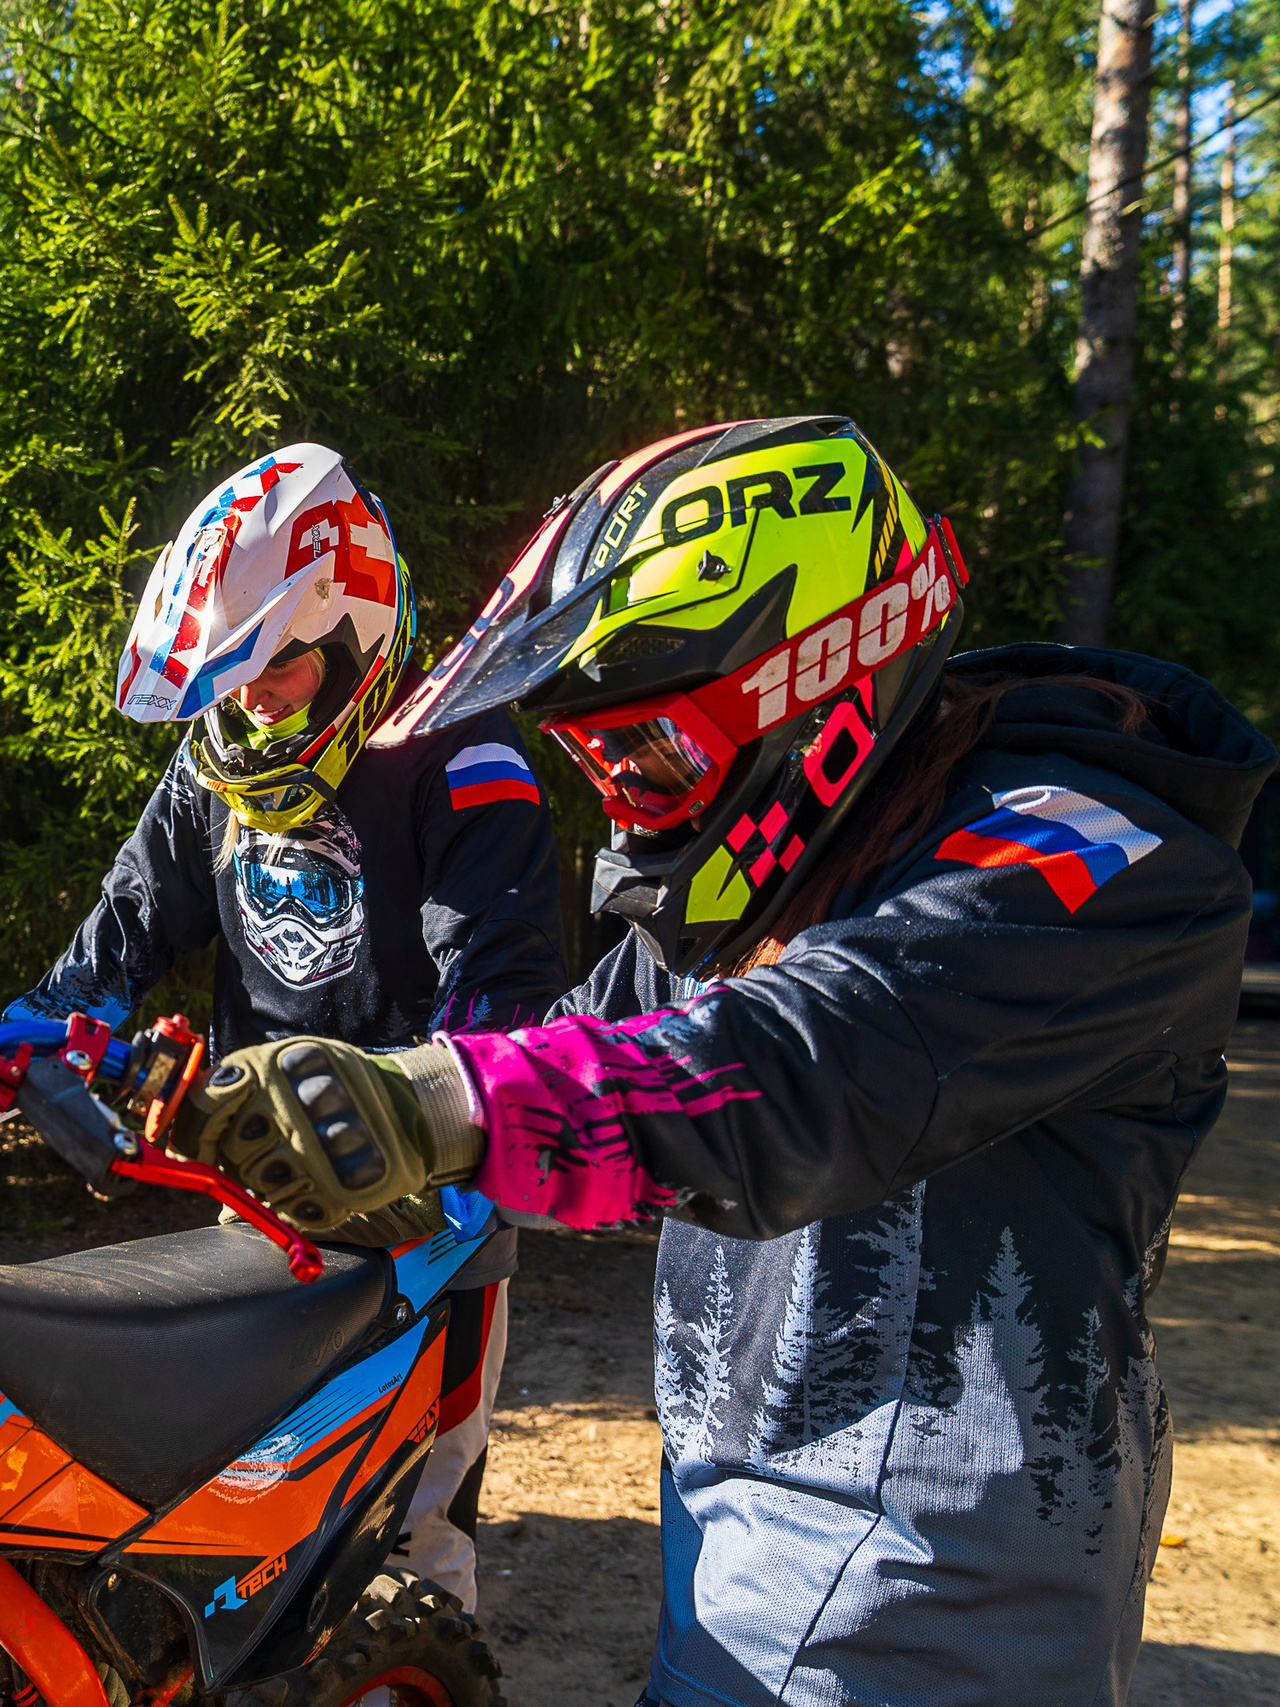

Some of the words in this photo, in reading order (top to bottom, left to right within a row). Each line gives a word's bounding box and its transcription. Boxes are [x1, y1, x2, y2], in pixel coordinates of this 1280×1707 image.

[589, 481, 649, 577] PORT
[661, 461, 852, 549] ORZ
[741, 545, 951, 730] 100%
[127, 694, 177, 711] NEXX
[377, 1373, 403, 1394] LotosArt
